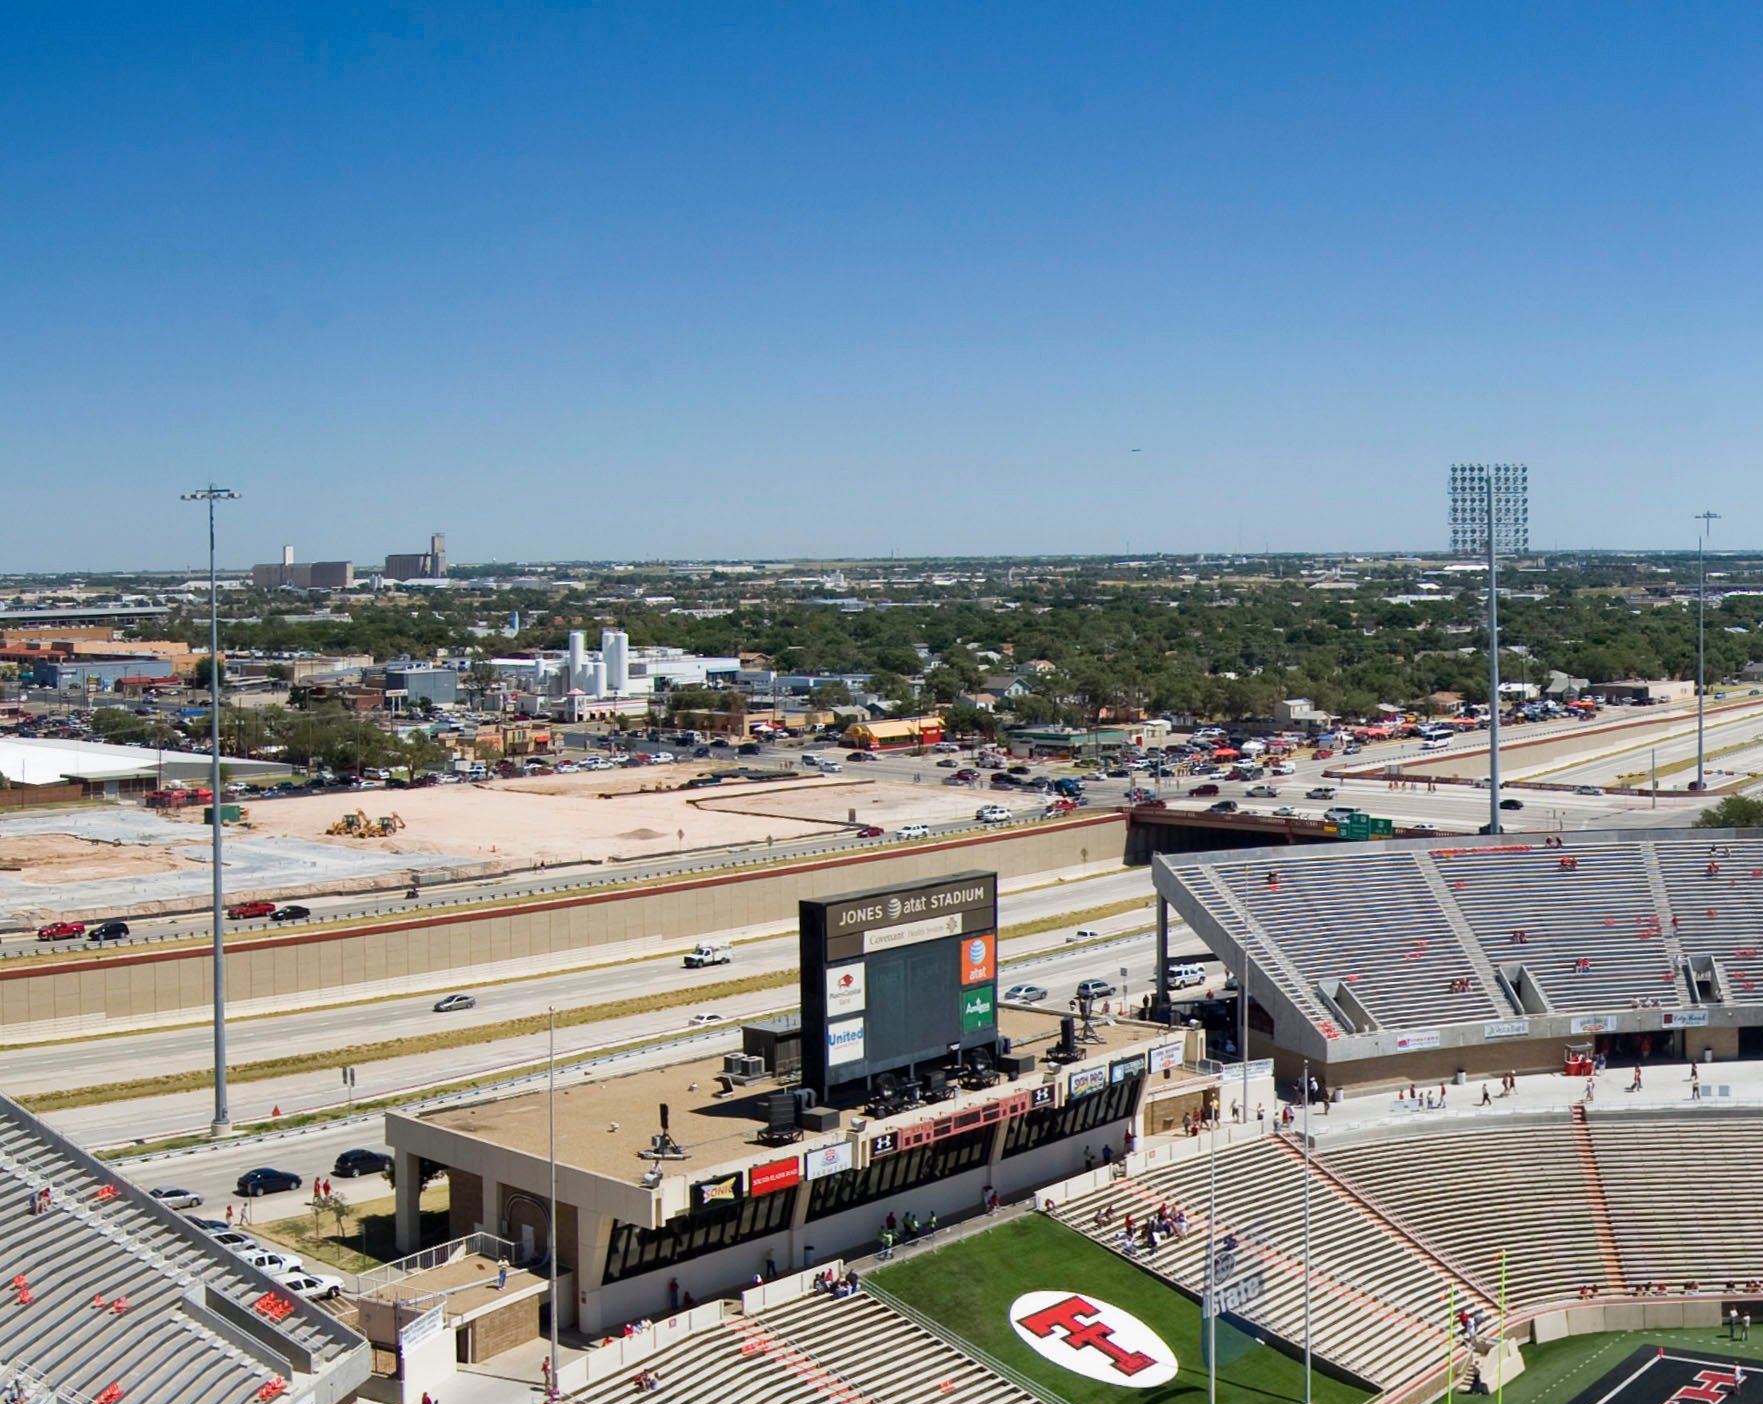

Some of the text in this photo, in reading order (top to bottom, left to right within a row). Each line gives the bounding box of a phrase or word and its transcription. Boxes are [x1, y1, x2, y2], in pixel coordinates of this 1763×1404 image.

[839, 905, 883, 926] JONES
[930, 886, 984, 909] STADIUM
[869, 929, 905, 945] Covenant
[828, 1026, 864, 1047] United
[703, 1183, 734, 1200] SONIC
